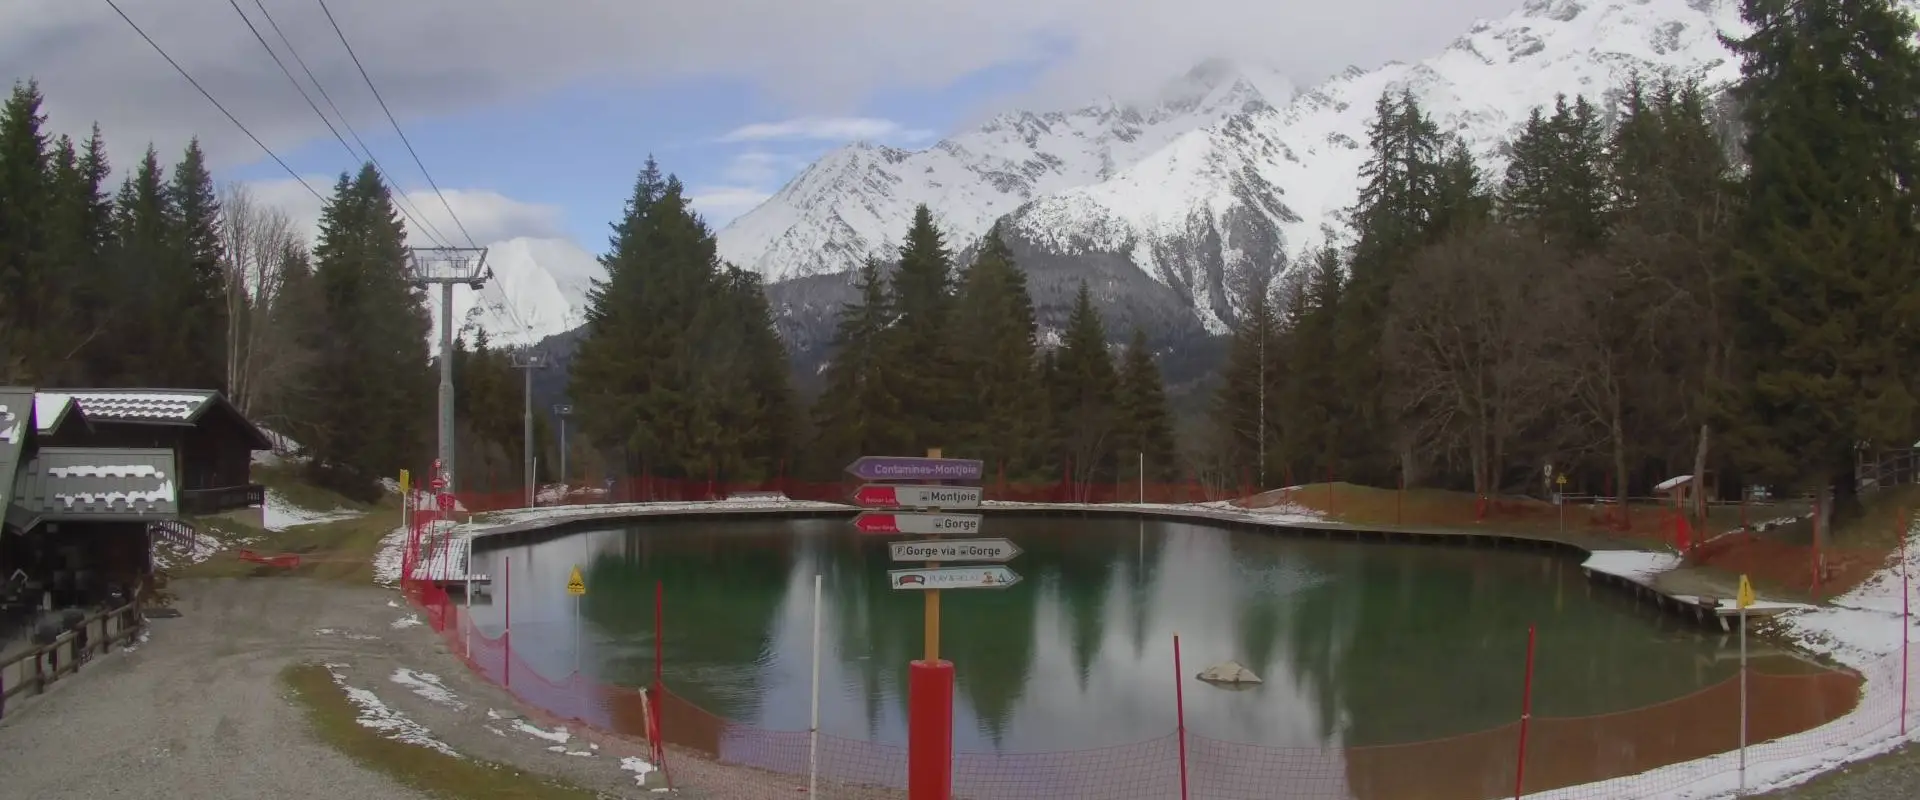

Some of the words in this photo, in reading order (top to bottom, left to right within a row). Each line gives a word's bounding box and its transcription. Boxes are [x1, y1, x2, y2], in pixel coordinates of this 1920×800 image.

[874, 464, 977, 476] Contamines-Montjoie
[931, 492, 977, 503] Montjoie
[945, 519, 977, 530] Gorge
[906, 546, 938, 557] Gorge
[941, 545, 956, 555] via
[969, 546, 1001, 557] Gorge
